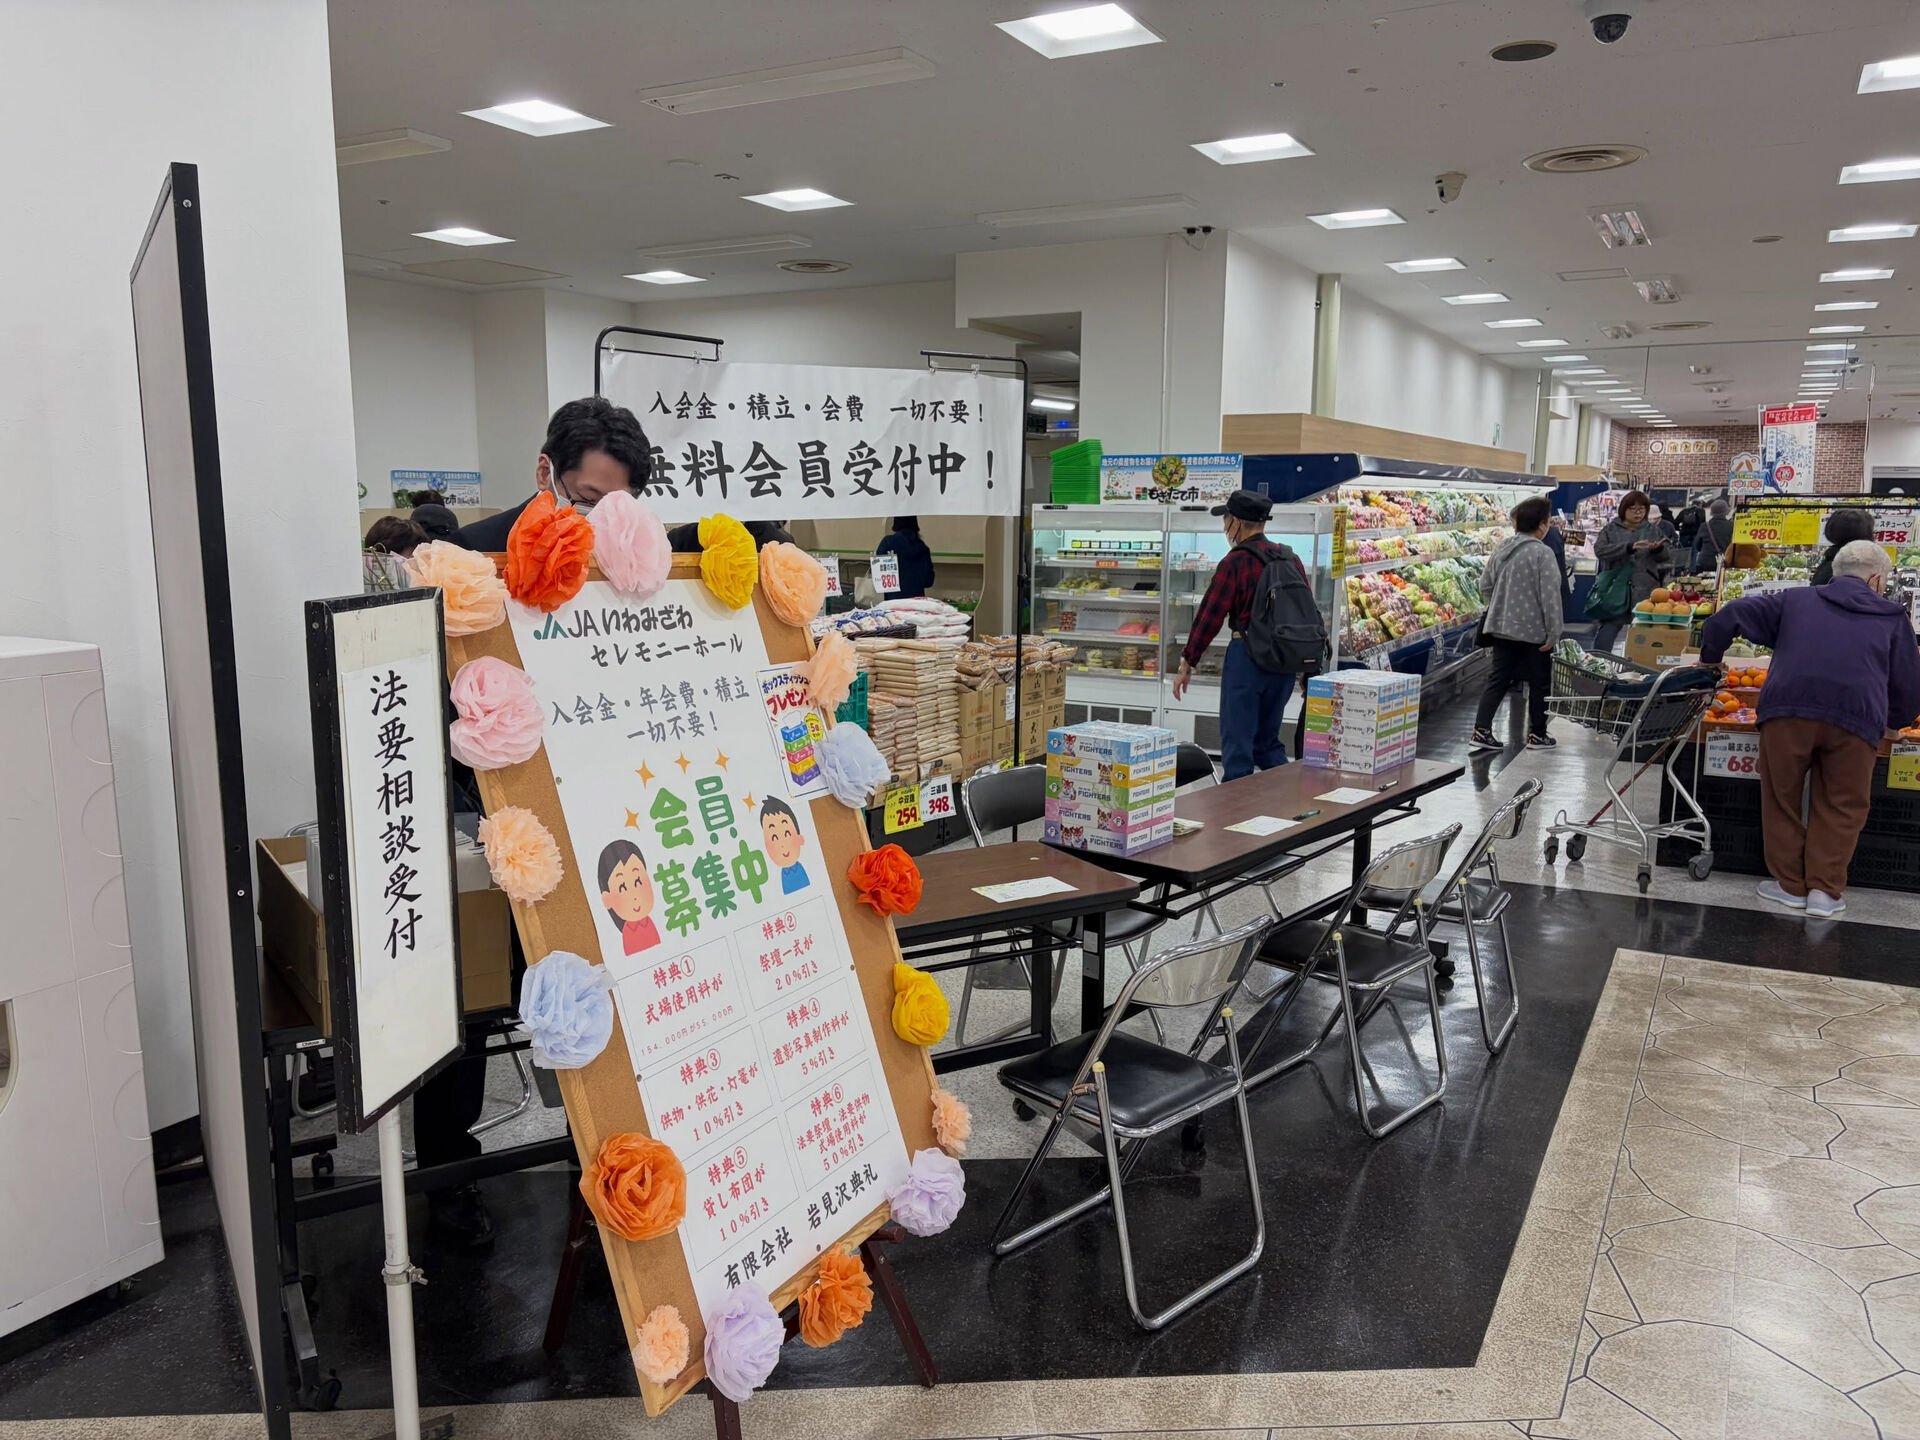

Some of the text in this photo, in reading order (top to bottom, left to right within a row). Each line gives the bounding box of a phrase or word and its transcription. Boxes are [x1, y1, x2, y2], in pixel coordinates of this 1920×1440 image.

[649, 389, 984, 424] 入会金・積立・会費 一切不要！
[638, 440, 994, 499] 無料会員受付中！
[1749, 528, 1778, 540] 980
[881, 574, 897, 588] 880
[590, 633, 743, 667] セレモニーホール
[551, 675, 750, 726] 入会金・年会費・積立
[766, 688, 810, 716] プレゼン
[626, 710, 718, 744] 一切不要！
[1079, 745, 1113, 756] FIGHTERS
[1060, 765, 1093, 776] FIGHTERS
[650, 776, 738, 849] 会員
[928, 795, 950, 815] 398
[1077, 789, 1111, 801] FIGHTERS
[370, 669, 422, 960] 法要相談受付
[896, 806, 918, 826] 259
[1058, 809, 1091, 821] FIGHTERS
[1090, 837, 1123, 850] FIGHTERS
[653, 840, 769, 937] 募集中
[762, 911, 797, 941] 特典②
[759, 933, 813, 973] 祭壇一式が
[653, 954, 695, 990] 特典①
[775, 960, 819, 990] 20%引き
[645, 973, 723, 1026] 式場使用料が
[787, 997, 820, 1029] 特典④
[773, 1011, 849, 1066] 遺影写真制作料が
[680, 1048, 721, 1085] 特典③
[801, 1046, 835, 1075] 5%引き
[810, 1083, 844, 1117] 特典⑥
[693, 1101, 744, 1141] 10%引き
[797, 1092, 870, 1150] 法要祭壇・法要供物
[819, 1110, 866, 1154] 式場使用料が
[707, 1145, 748, 1186] 特典⑤
[823, 1134, 864, 1171] 50%引き
[703, 1163, 765, 1220] 貸し布団が
[720, 1197, 769, 1242] 10%引き
[724, 1163, 878, 1290] 有限会社 岩見沢典礼
